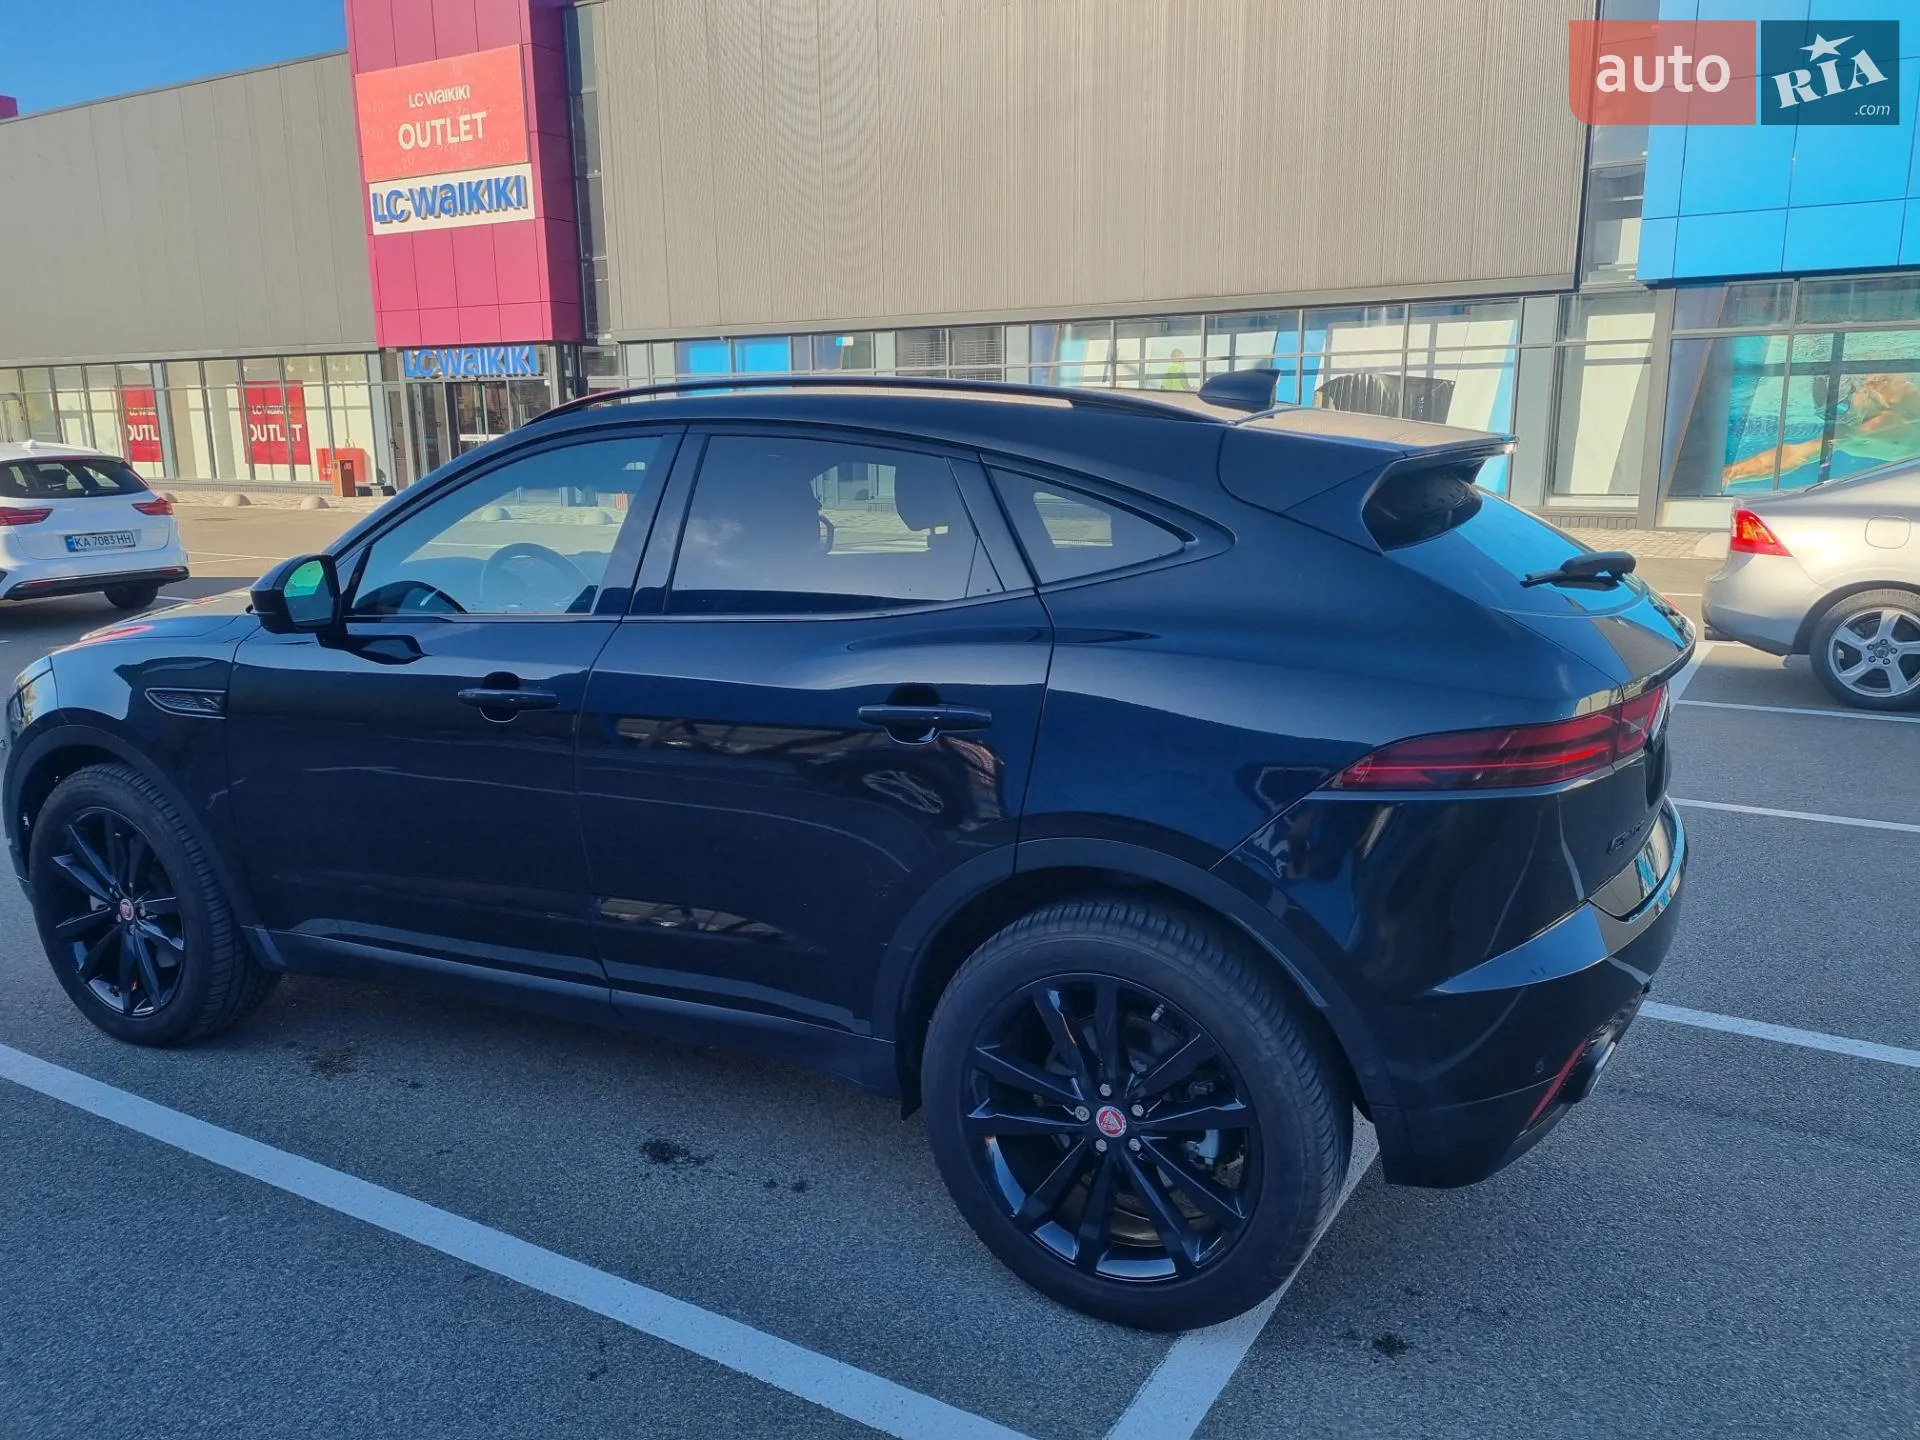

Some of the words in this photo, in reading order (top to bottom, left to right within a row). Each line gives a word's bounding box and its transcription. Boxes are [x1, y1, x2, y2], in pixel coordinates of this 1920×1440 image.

[408, 92, 425, 108] LC
[398, 111, 487, 151] OUTLET
[372, 189, 408, 223] LC
[403, 348, 435, 377] LC
[249, 423, 303, 442] OUTLT
[74, 537, 91, 548] KA
[116, 533, 132, 545] HH
